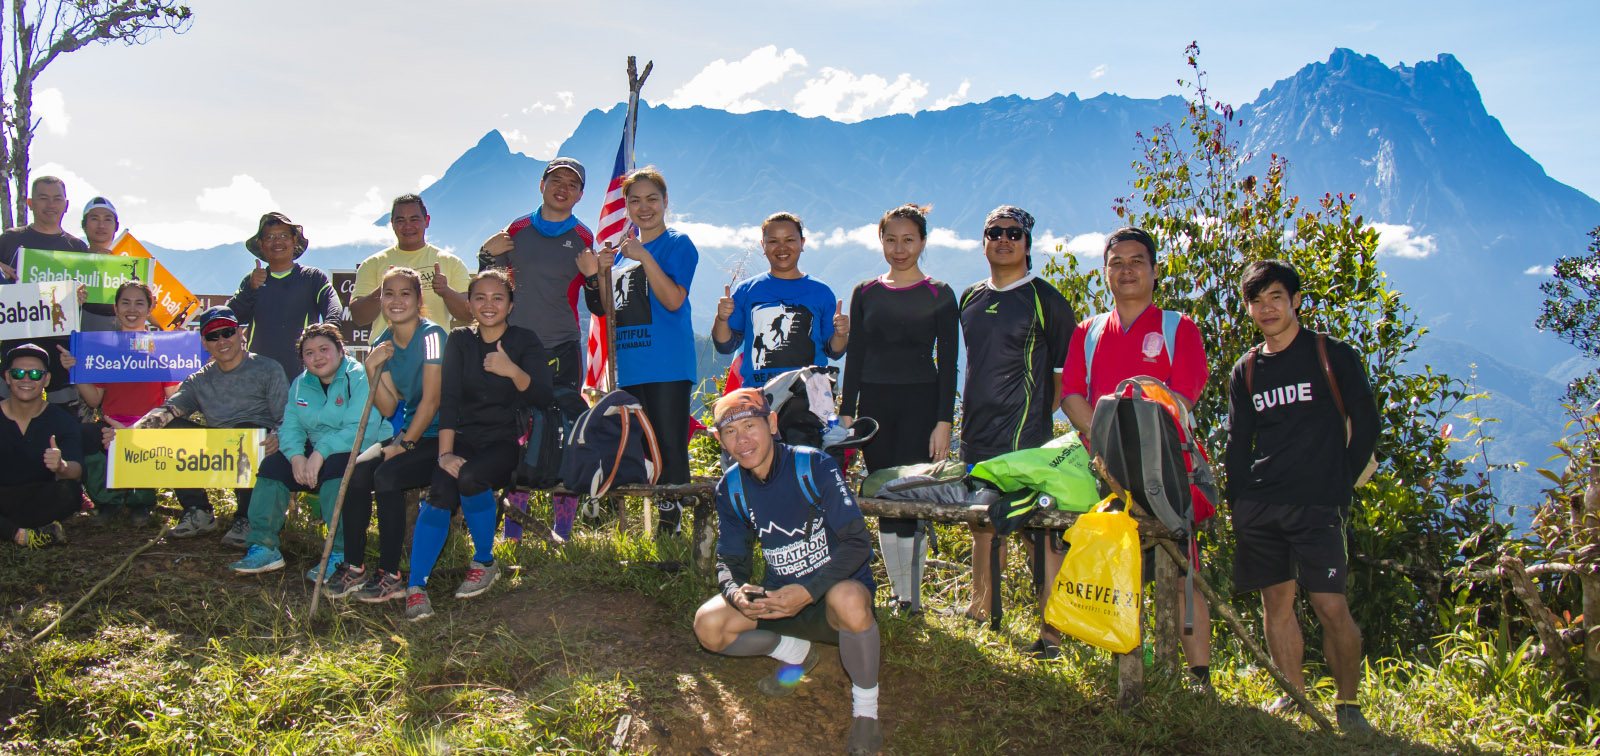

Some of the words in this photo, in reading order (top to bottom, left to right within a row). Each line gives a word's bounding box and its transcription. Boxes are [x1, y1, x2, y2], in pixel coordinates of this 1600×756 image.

[161, 291, 182, 317] bah
[85, 354, 202, 370] #SeaYouInSabah
[1253, 383, 1313, 412] GUIDE
[124, 446, 174, 464] Welcome
[155, 459, 167, 471] to
[175, 448, 234, 471] Sabah
[774, 559, 808, 576] TOBER
[808, 545, 829, 565] 2017
[1057, 580, 1121, 606] FOREVER
[1125, 591, 1140, 609] 21
